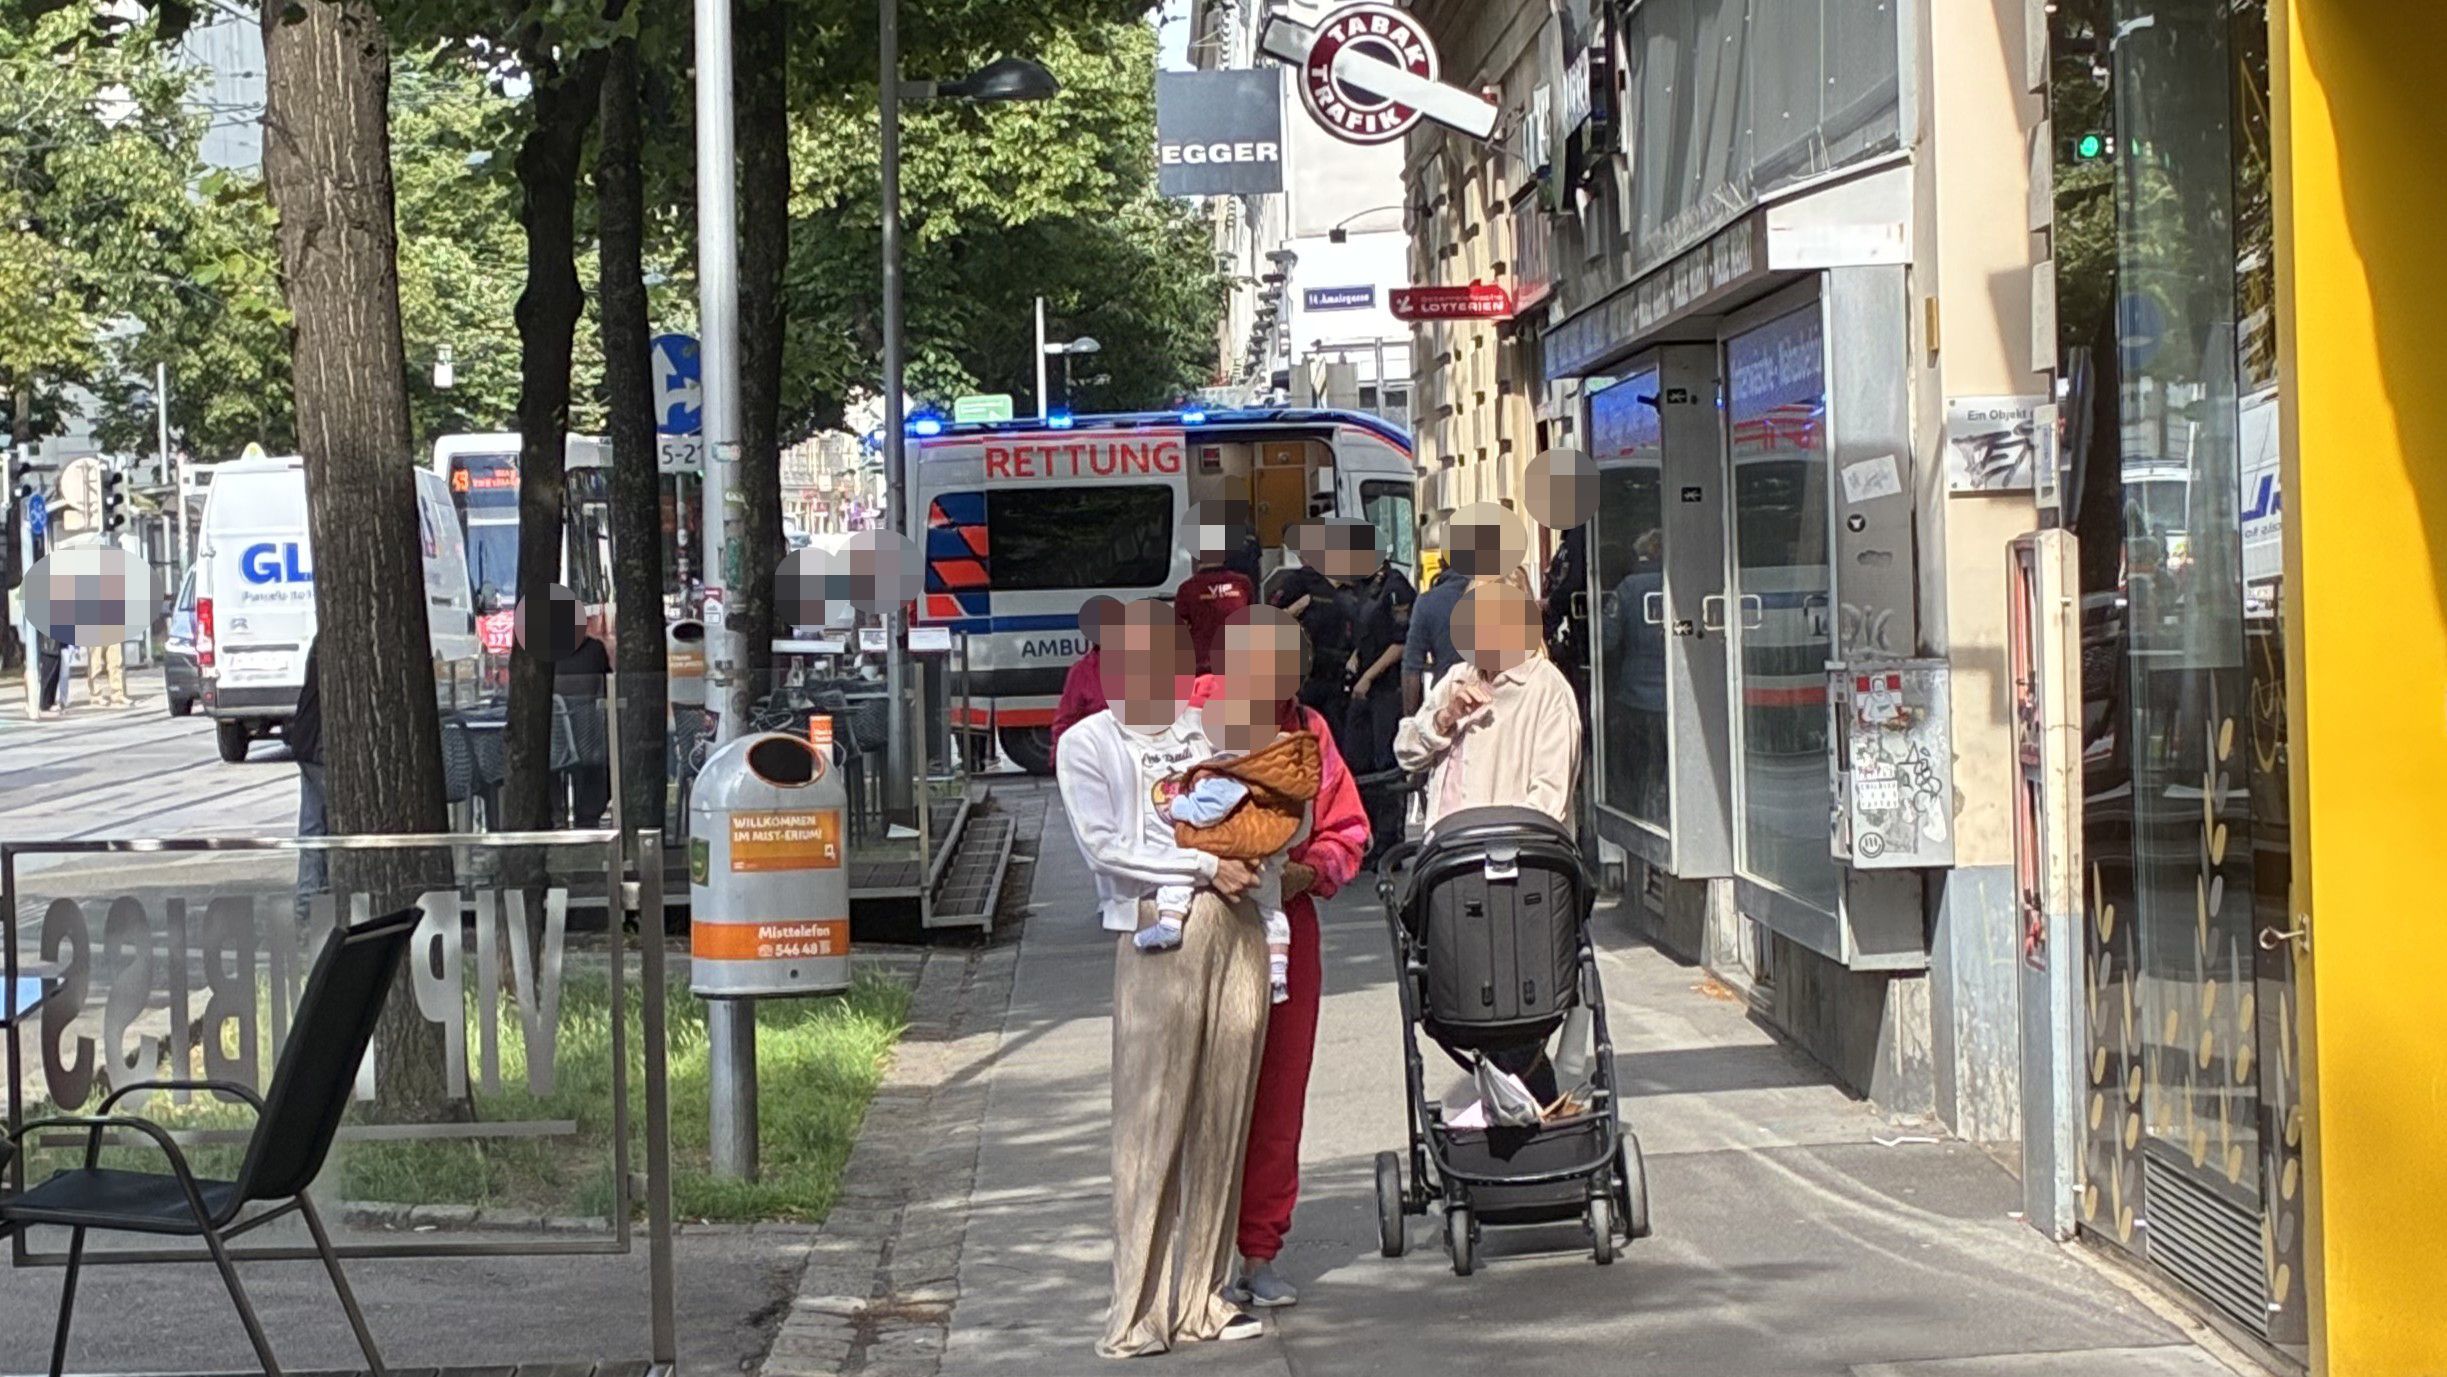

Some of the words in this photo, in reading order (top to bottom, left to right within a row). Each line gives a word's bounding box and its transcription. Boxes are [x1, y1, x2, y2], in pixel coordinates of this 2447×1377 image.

[1327, 14, 1425, 66] TABAK
[1311, 63, 1402, 133] TRAFIK
[1161, 142, 1279, 165] EGGER
[1421, 302, 1504, 313] LOTTERIEN
[1989, 408, 2027, 421] Objekt
[661, 443, 704, 465] 5-2
[985, 440, 1181, 479] RETTUNG
[238, 542, 315, 585] GL
[1021, 638, 1096, 659] AMBU
[733, 815, 817, 829] WILLKOMMEN
[734, 831, 750, 842] IM
[758, 924, 831, 940] Misttelefon
[775, 943, 800, 957] 546
[801, 942, 818, 956] 48
